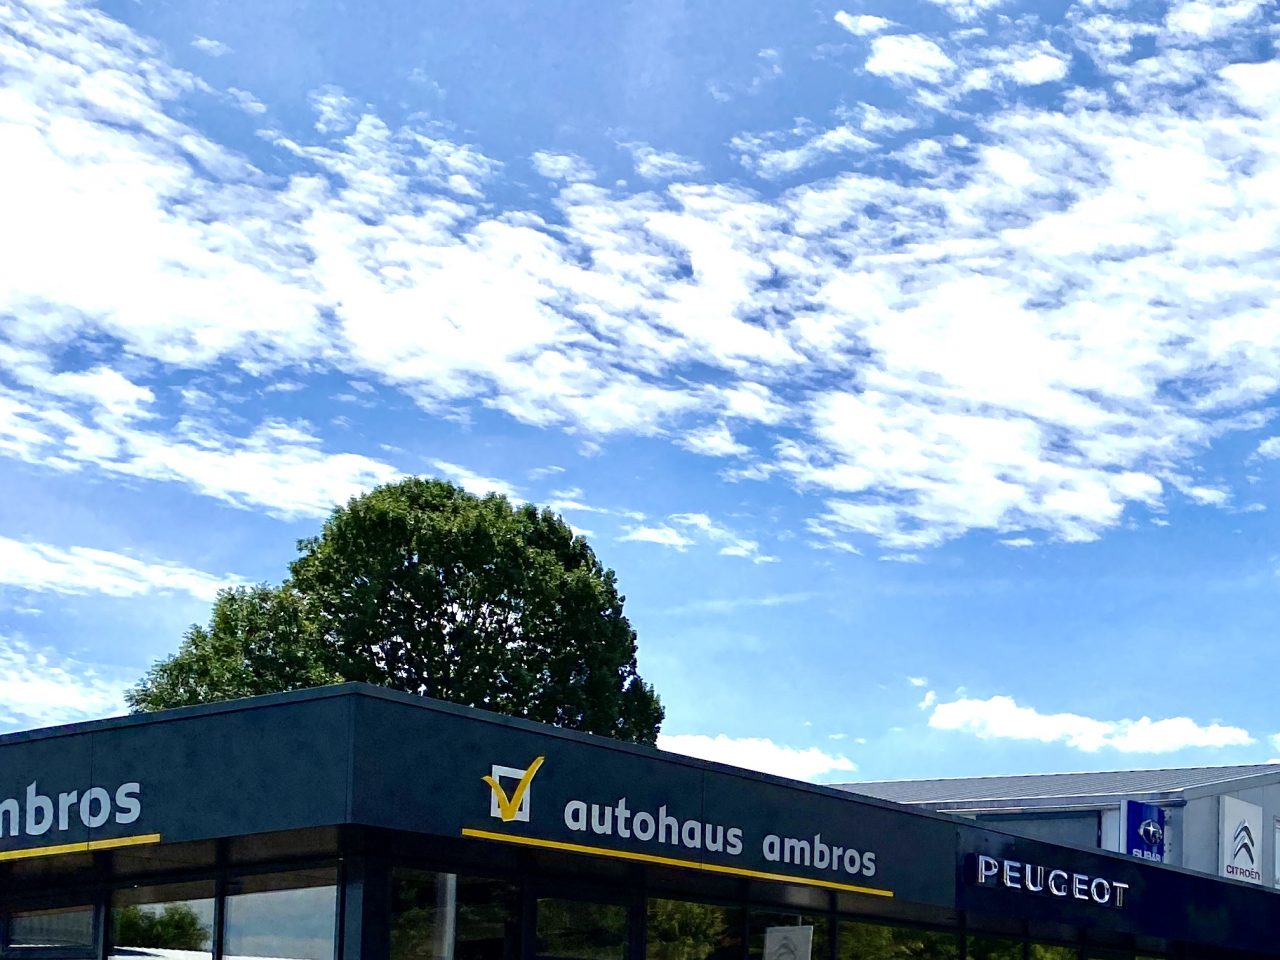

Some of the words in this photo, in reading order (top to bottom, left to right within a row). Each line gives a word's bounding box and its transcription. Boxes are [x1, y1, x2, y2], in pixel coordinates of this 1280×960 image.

[563, 796, 744, 856] autohaus
[762, 832, 877, 878] ambros
[1132, 848, 1164, 864] SUBAR
[978, 854, 1130, 908] PEUGEOT
